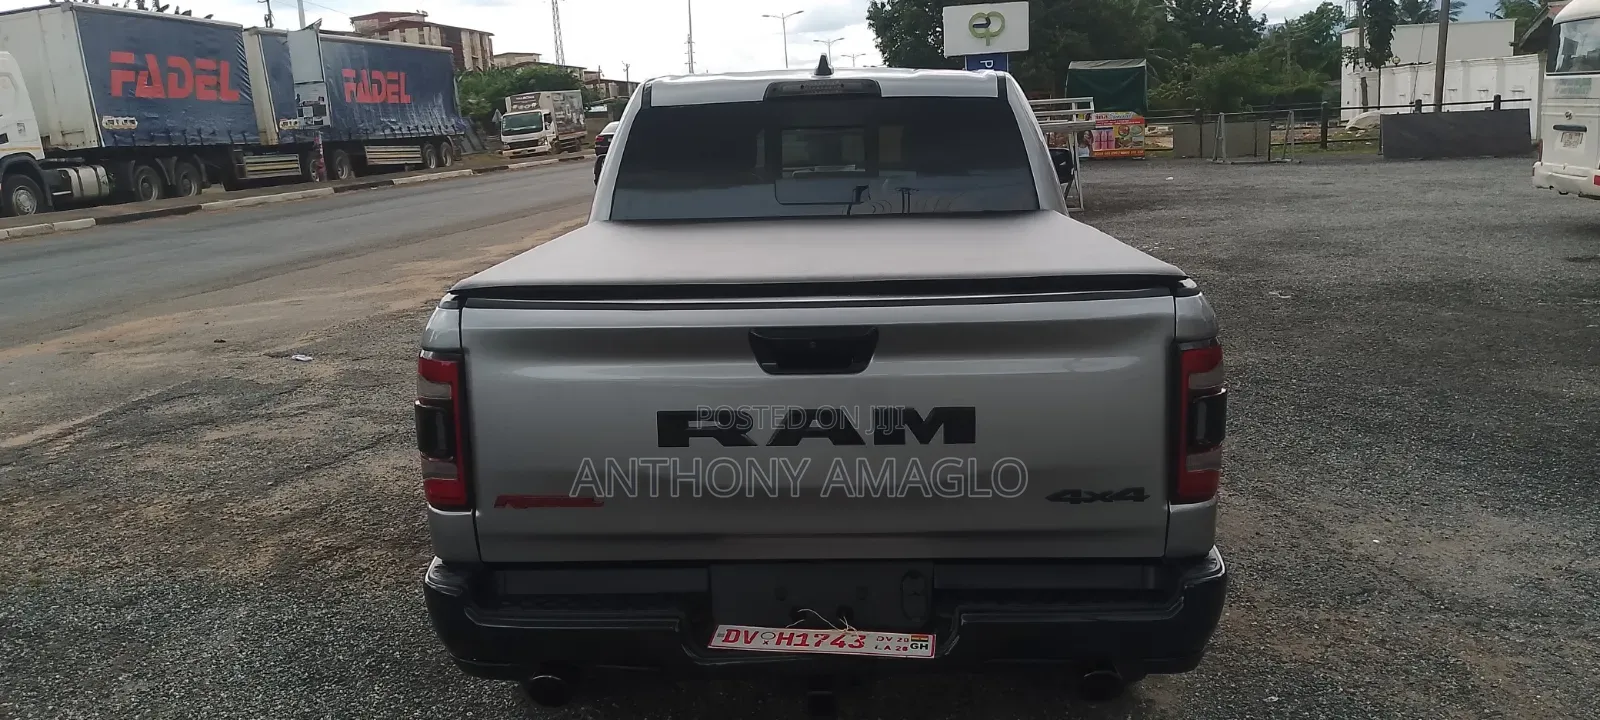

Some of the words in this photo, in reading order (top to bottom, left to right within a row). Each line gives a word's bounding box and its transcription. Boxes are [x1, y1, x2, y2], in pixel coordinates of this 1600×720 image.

[109, 50, 240, 101] FADEL
[341, 68, 411, 104] FADEL
[656, 406, 977, 447] RAM
[721, 628, 759, 645] DV
[775, 631, 867, 649] H1743
[910, 642, 929, 650] GH
